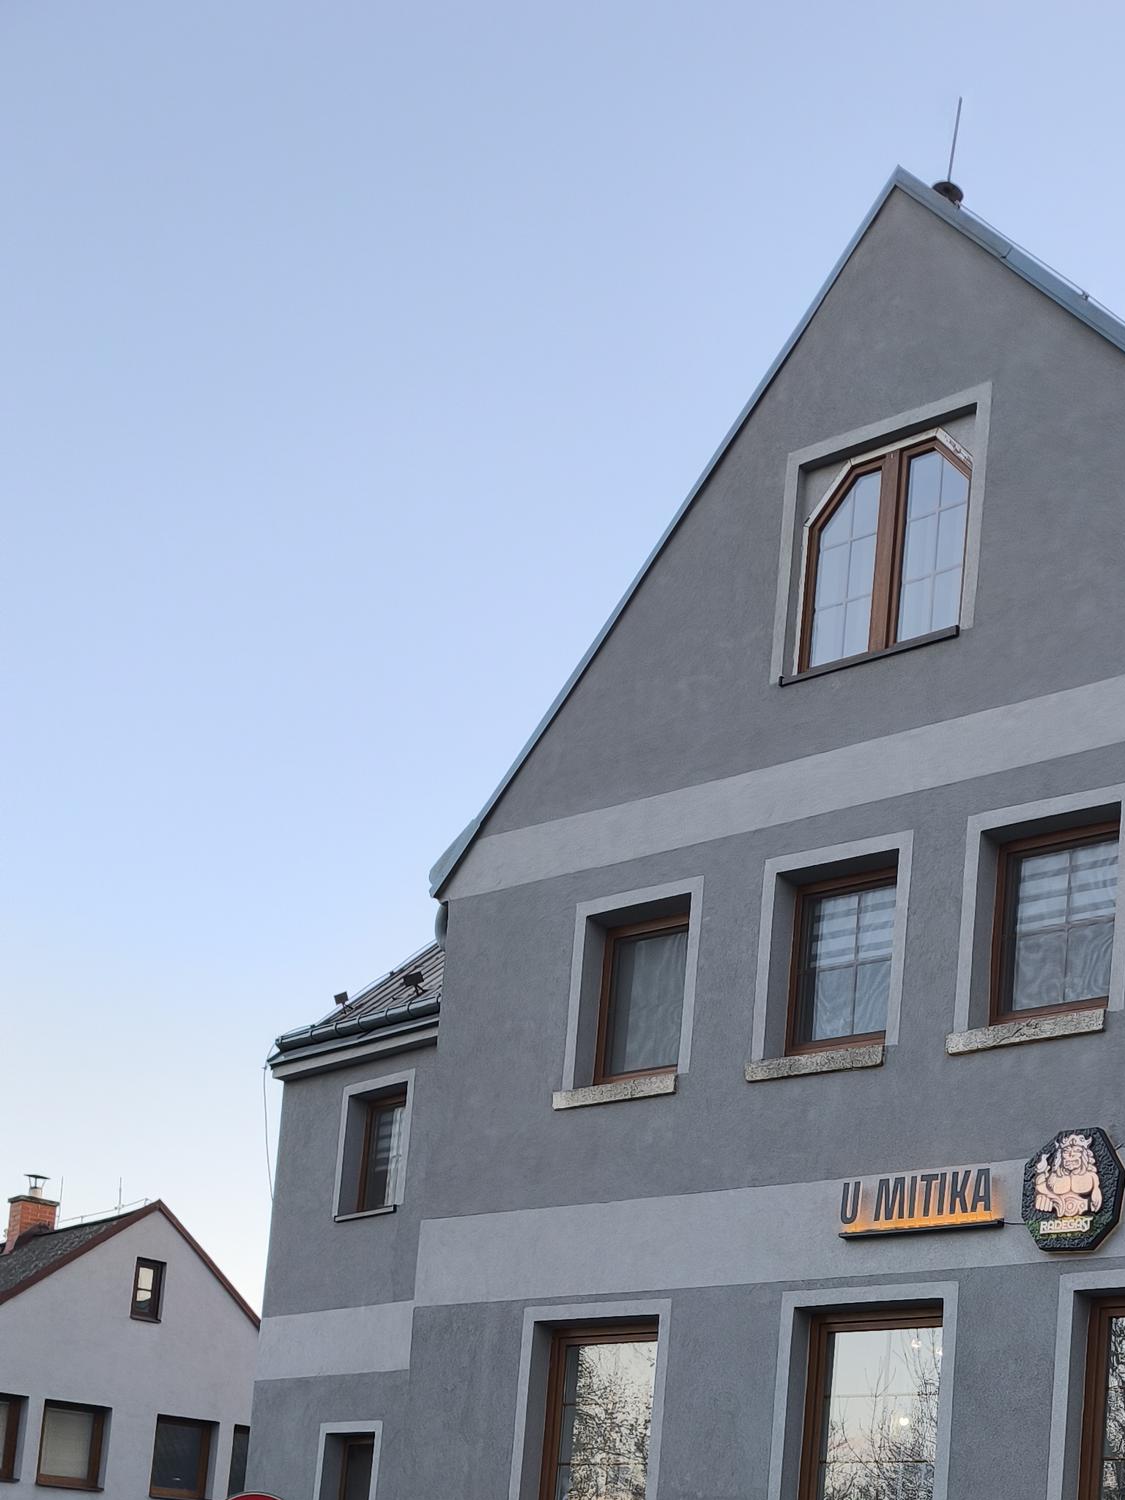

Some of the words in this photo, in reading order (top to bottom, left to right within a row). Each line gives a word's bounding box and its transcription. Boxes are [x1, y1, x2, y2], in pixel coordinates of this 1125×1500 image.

[840, 1181, 861, 1224] U
[873, 1168, 992, 1222] MITIKA
[1040, 1216, 1093, 1233] RADEGAST
